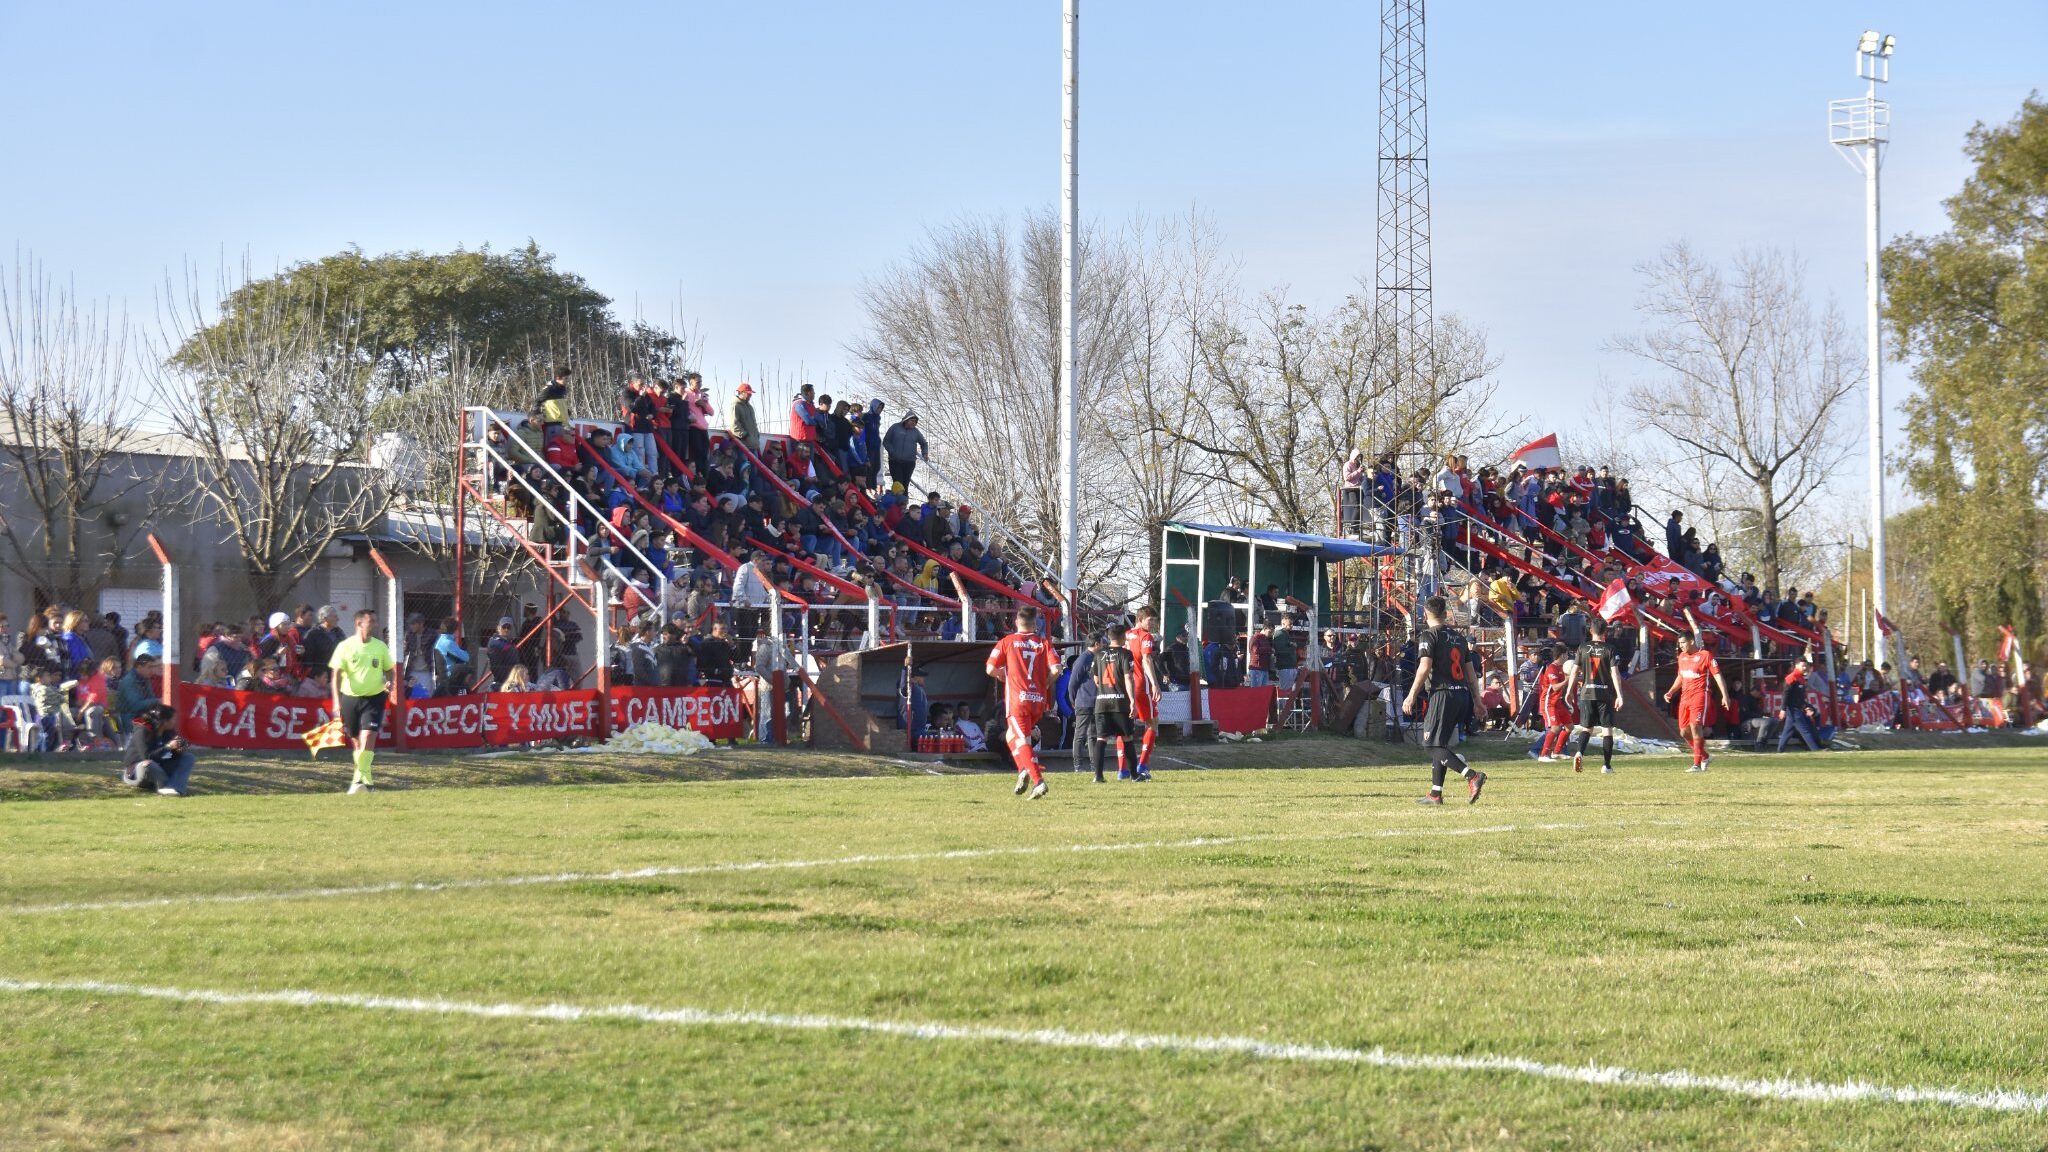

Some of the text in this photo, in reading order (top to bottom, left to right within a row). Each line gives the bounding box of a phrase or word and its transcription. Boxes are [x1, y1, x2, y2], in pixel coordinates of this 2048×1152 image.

[1022, 650, 1037, 680] 7
[1102, 661, 1116, 688] 4
[1450, 647, 1464, 681] 8
[1589, 656, 1601, 682] 7
[266, 705, 307, 739] SE
[404, 702, 498, 737] CRECE
[508, 703, 527, 730] Y
[626, 689, 740, 727] CAMPEÓN
